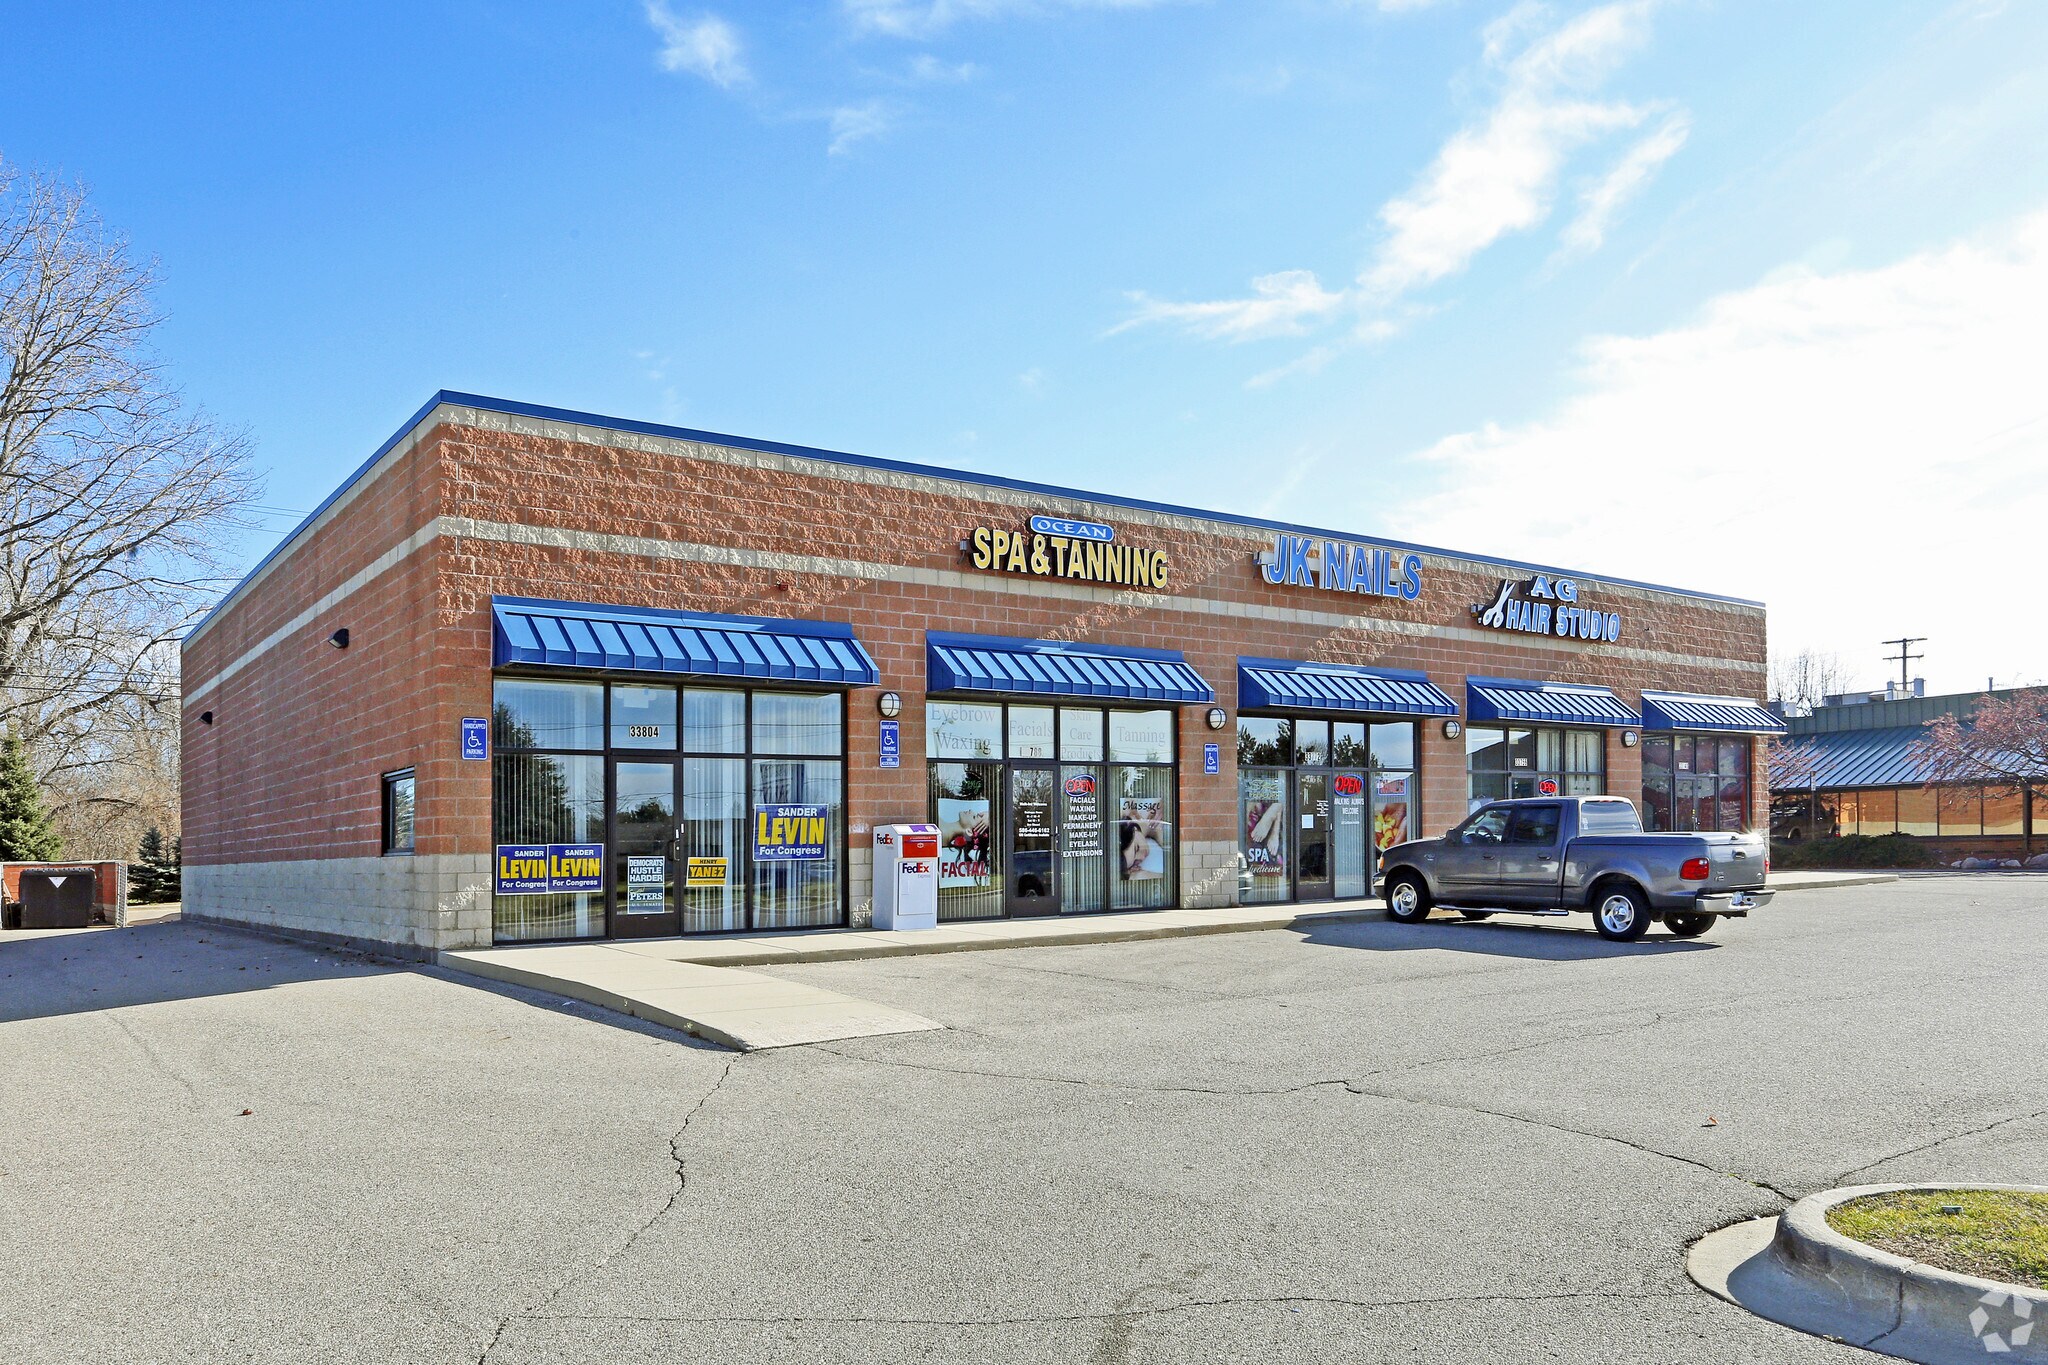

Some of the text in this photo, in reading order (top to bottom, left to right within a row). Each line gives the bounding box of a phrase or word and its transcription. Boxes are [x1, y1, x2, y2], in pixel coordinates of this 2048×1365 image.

[1037, 519, 1108, 538] OCEAN
[973, 527, 1168, 589] SPA & TANNING
[1263, 534, 1423, 600] JK NAILS
[1531, 575, 1578, 603] AG
[1506, 599, 1621, 643] HAIR STUDIO
[931, 703, 996, 722] Eyebrow
[1070, 711, 1091, 721] Skin
[630, 726, 659, 738] 33804
[1009, 720, 1054, 737] Facials
[1069, 728, 1092, 740] Care
[1116, 726, 1166, 747] Tanning
[938, 732, 991, 755] Waxing
[1061, 746, 1101, 760] Products
[1066, 779, 1095, 793] OPEN
[1335, 775, 1363, 794] OPEN
[777, 807, 818, 817] SANDER
[1122, 800, 1161, 815] Massage
[757, 812, 826, 846] LEVIN
[1063, 822, 1101, 830] PERMANENT
[876, 833, 894, 845] FedEx
[1069, 831, 1098, 839] MAKE-UP
[1069, 840, 1098, 848] EYELASH
[759, 846, 822, 857] For Congress
[1062, 849, 1103, 858] EXTENSIONS
[1248, 848, 1270, 862] SPA
[550, 854, 601, 878] LEVIN
[629, 859, 664, 867] DEMOCRATS
[902, 862, 929, 874] FedEx
[630, 866, 662, 874] HUSTLE
[689, 866, 725, 878] YANEZ
[941, 861, 987, 879] FACIAL
[565, 879, 598, 888] Congress
[629, 874, 663, 882] HARDER
[630, 892, 663, 901] PETERS
